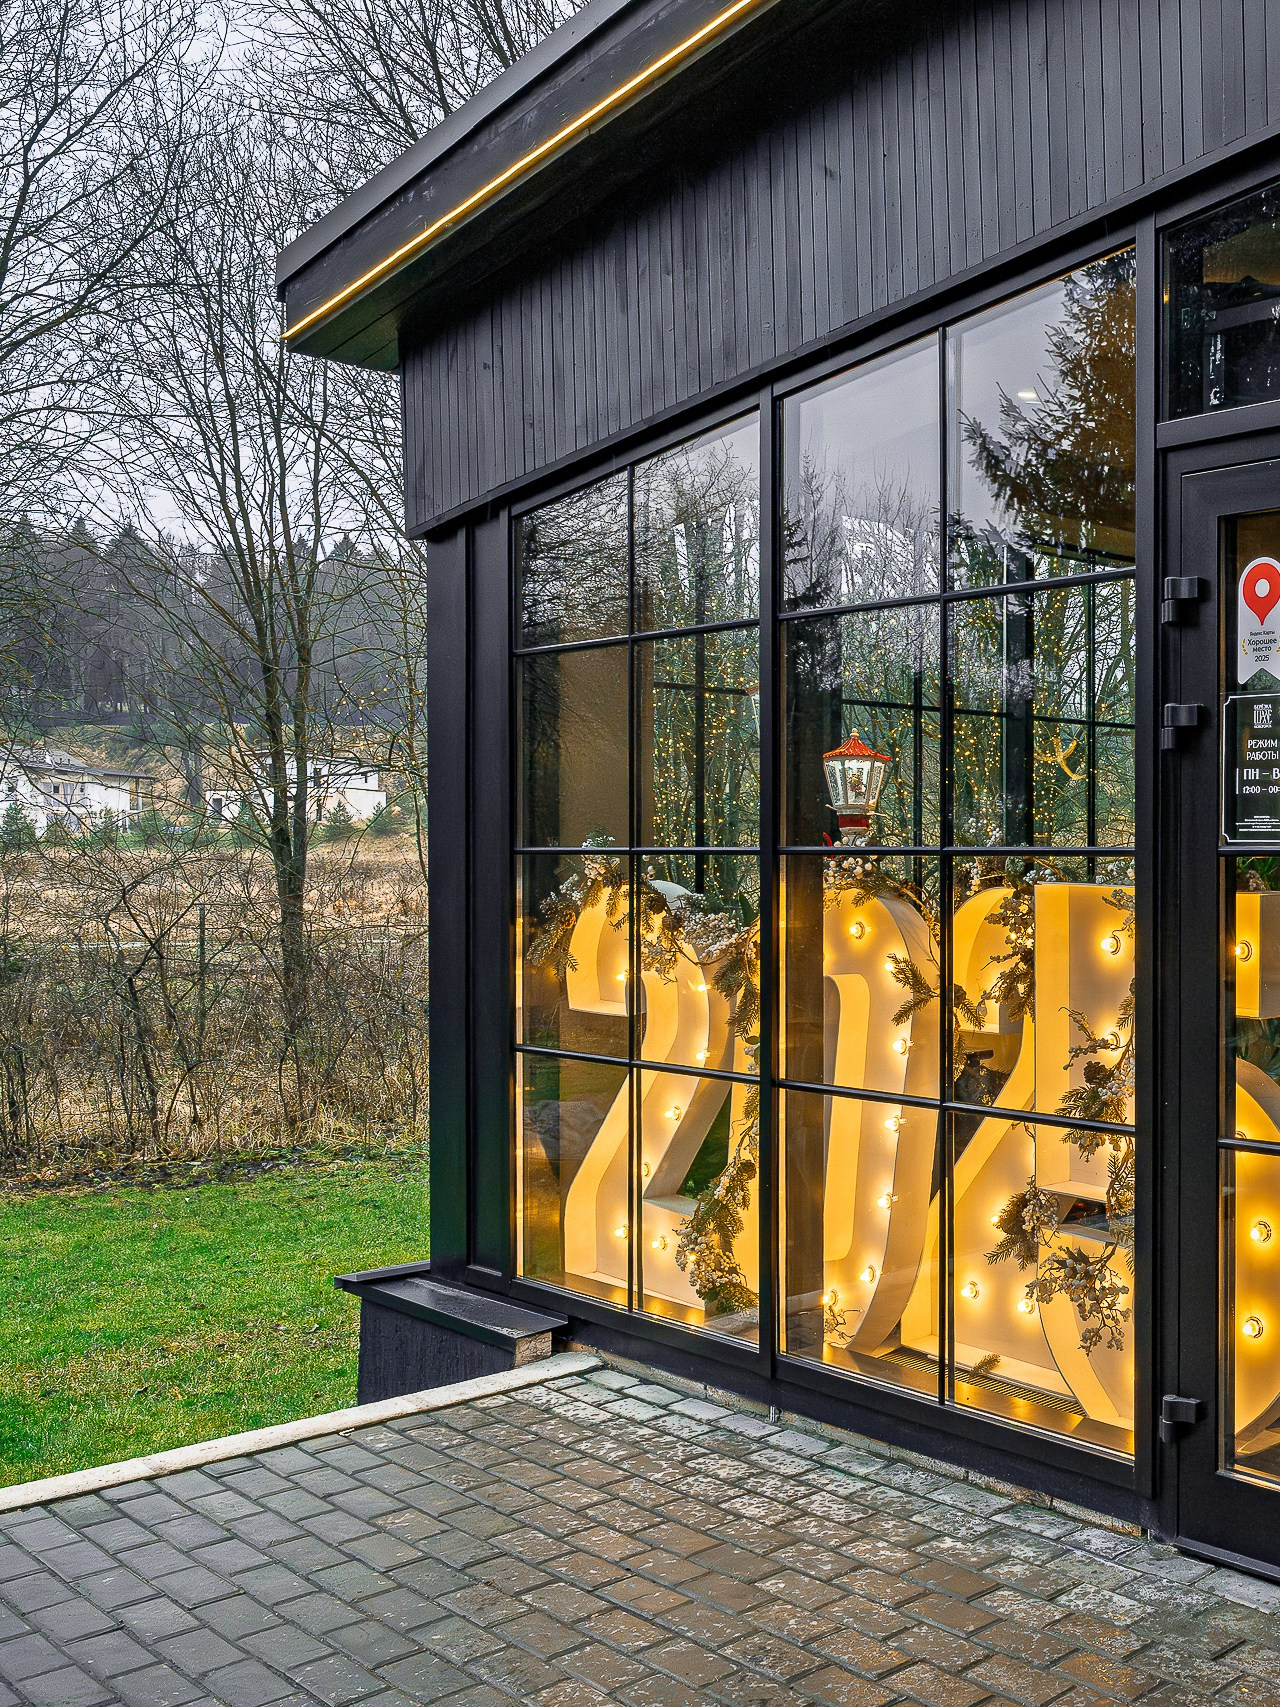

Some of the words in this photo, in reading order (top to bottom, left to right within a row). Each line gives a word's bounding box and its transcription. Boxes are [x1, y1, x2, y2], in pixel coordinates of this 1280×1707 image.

[1247, 638, 1277, 646] Хорошее
[1255, 654, 1269, 662] 2025
[1247, 739, 1278, 749] РЕЖИМ
[1246, 751, 1279, 760] РАБОТЫ
[1243, 768, 1260, 780] ПН
[1243, 786, 1260, 794] 12:00
